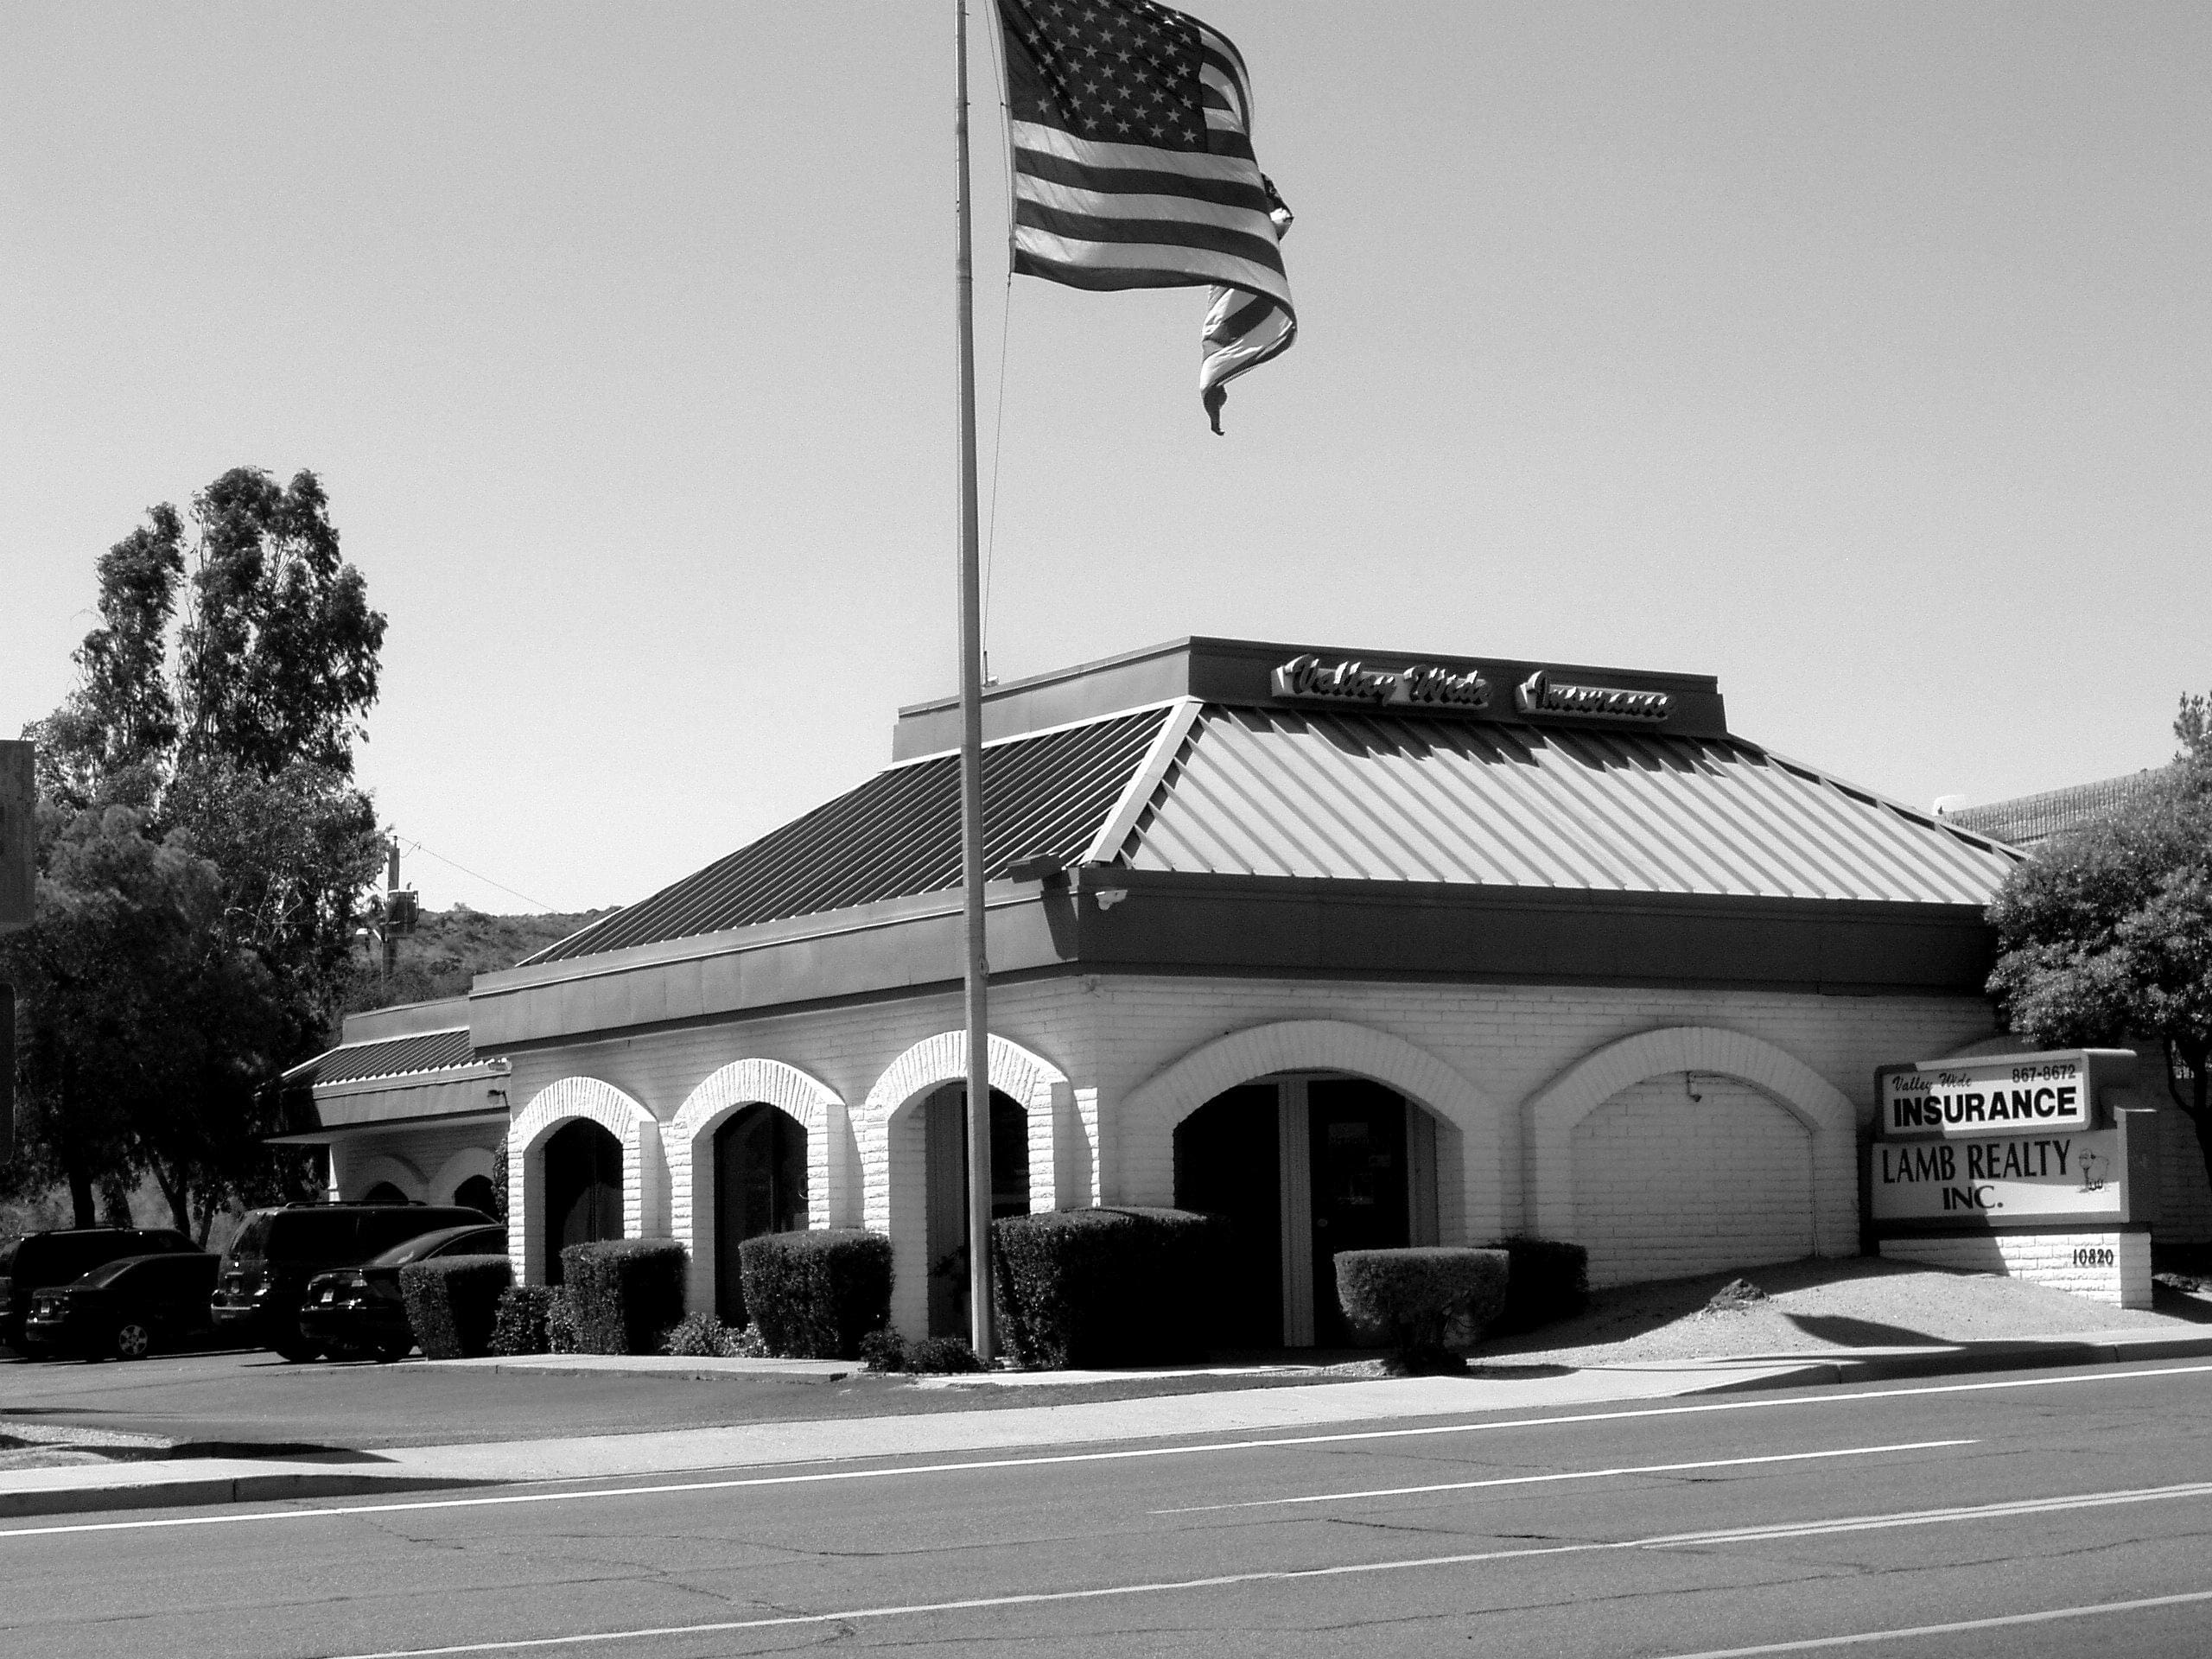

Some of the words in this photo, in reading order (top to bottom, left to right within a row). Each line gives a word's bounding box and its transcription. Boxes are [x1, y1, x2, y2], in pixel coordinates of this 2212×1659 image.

[1892, 1075, 1933, 1094] Valley
[1939, 1072, 1972, 1088] Wide
[2012, 1064, 2076, 1084] 867-8672
[1893, 1086, 2077, 1128] INSURANCE
[1882, 1144, 1956, 1184] LAMB
[1967, 1139, 2071, 1180] REALTY
[1942, 1185, 2004, 1211] INC.
[2072, 1249, 2114, 1266] 10820
